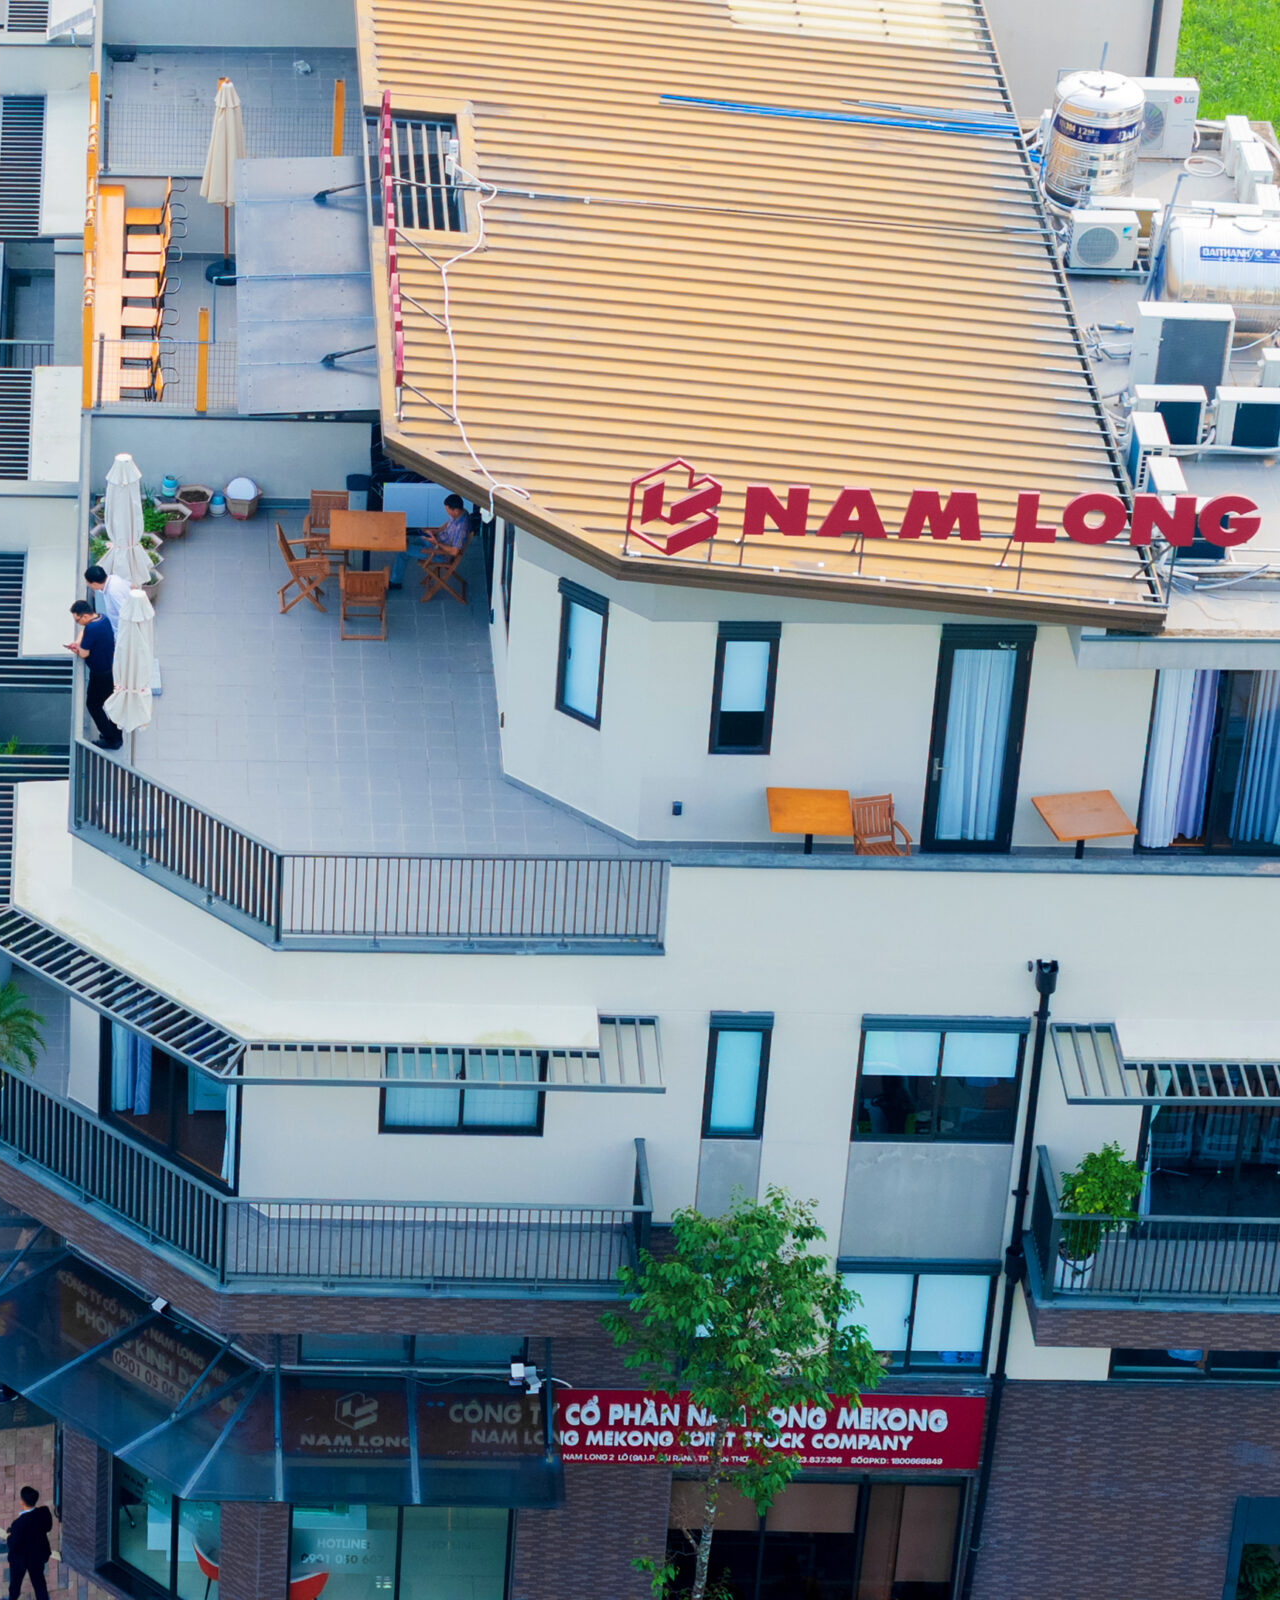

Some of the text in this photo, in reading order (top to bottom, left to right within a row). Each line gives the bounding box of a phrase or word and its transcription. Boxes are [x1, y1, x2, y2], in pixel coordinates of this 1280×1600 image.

[741, 484, 1262, 547] NAM LONG
[113, 1349, 141, 1374] 0901
[145, 1370, 159, 1389] 05
[135, 1339, 176, 1377] KINH
[449, 1399, 522, 1424] CÔNG
[565, 1395, 601, 1425] CỔ
[608, 1397, 680, 1426] PHẦN
[758, 1405, 827, 1430] ONG
[837, 1407, 948, 1433] MEKONG
[300, 1434, 352, 1446] NAM
[472, 1429, 518, 1445] NAM
[586, 1430, 674, 1447] MEKONG
[680, 1430, 736, 1448] OIT
[811, 1433, 913, 1451] COMPANY
[563, 1453, 583, 1461] NAM
[584, 1453, 607, 1461] LONG
[317, 1538, 371, 1550] HOTLINE:
